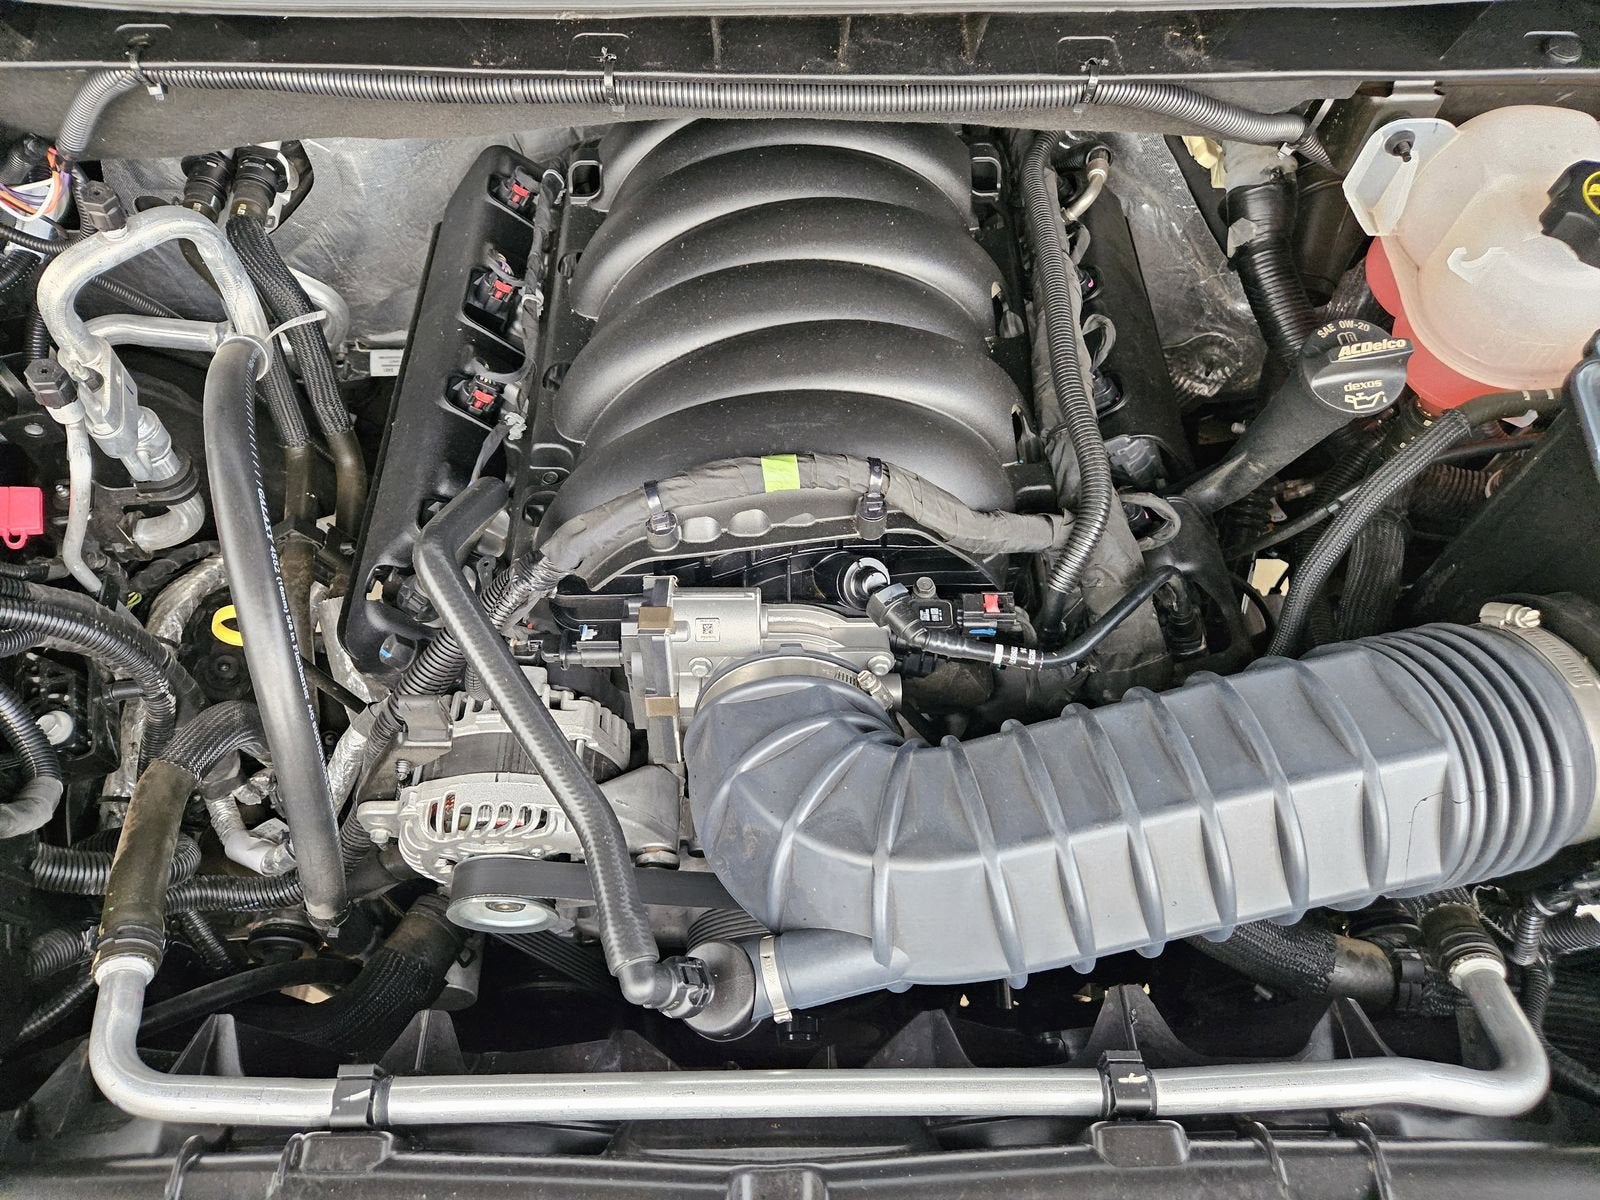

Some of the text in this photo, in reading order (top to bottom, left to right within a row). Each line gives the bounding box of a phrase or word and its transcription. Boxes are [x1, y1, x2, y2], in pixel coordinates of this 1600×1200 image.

[1317, 320, 1370, 338] SAE 0W-20
[1338, 339, 1406, 358] ACDelco
[1344, 380, 1382, 391] dexos
[258, 488, 274, 543] GALAXY
[285, 614, 295, 631] 5/8
